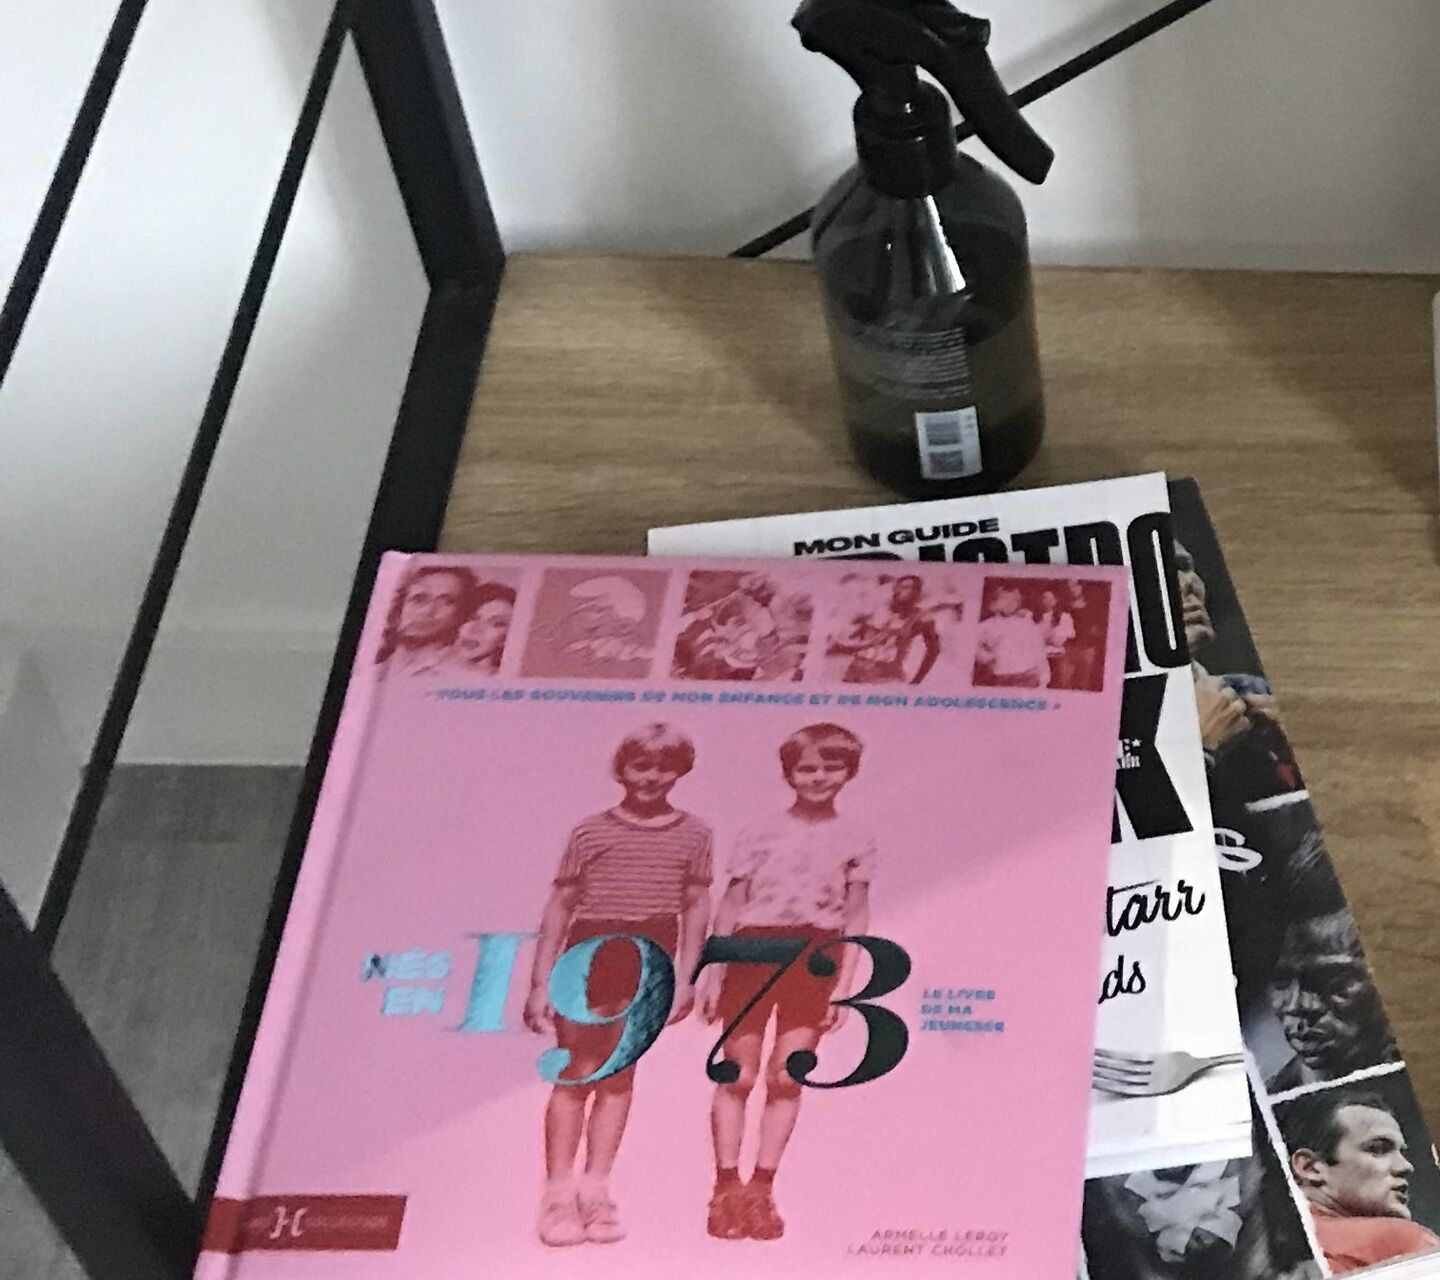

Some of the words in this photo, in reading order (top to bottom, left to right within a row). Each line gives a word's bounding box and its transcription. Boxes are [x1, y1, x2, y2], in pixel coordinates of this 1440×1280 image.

[793, 533, 880, 556] MON
[888, 518, 999, 544] GUIDE
[381, 986, 445, 1016] EN
[446, 933, 912, 1089] 1973
[848, 1244, 925, 1257] LAURENT
[931, 1244, 1008, 1258] CHOLLET
[871, 1229, 948, 1242] ARMELLE
[955, 1230, 1009, 1243] LEROY
